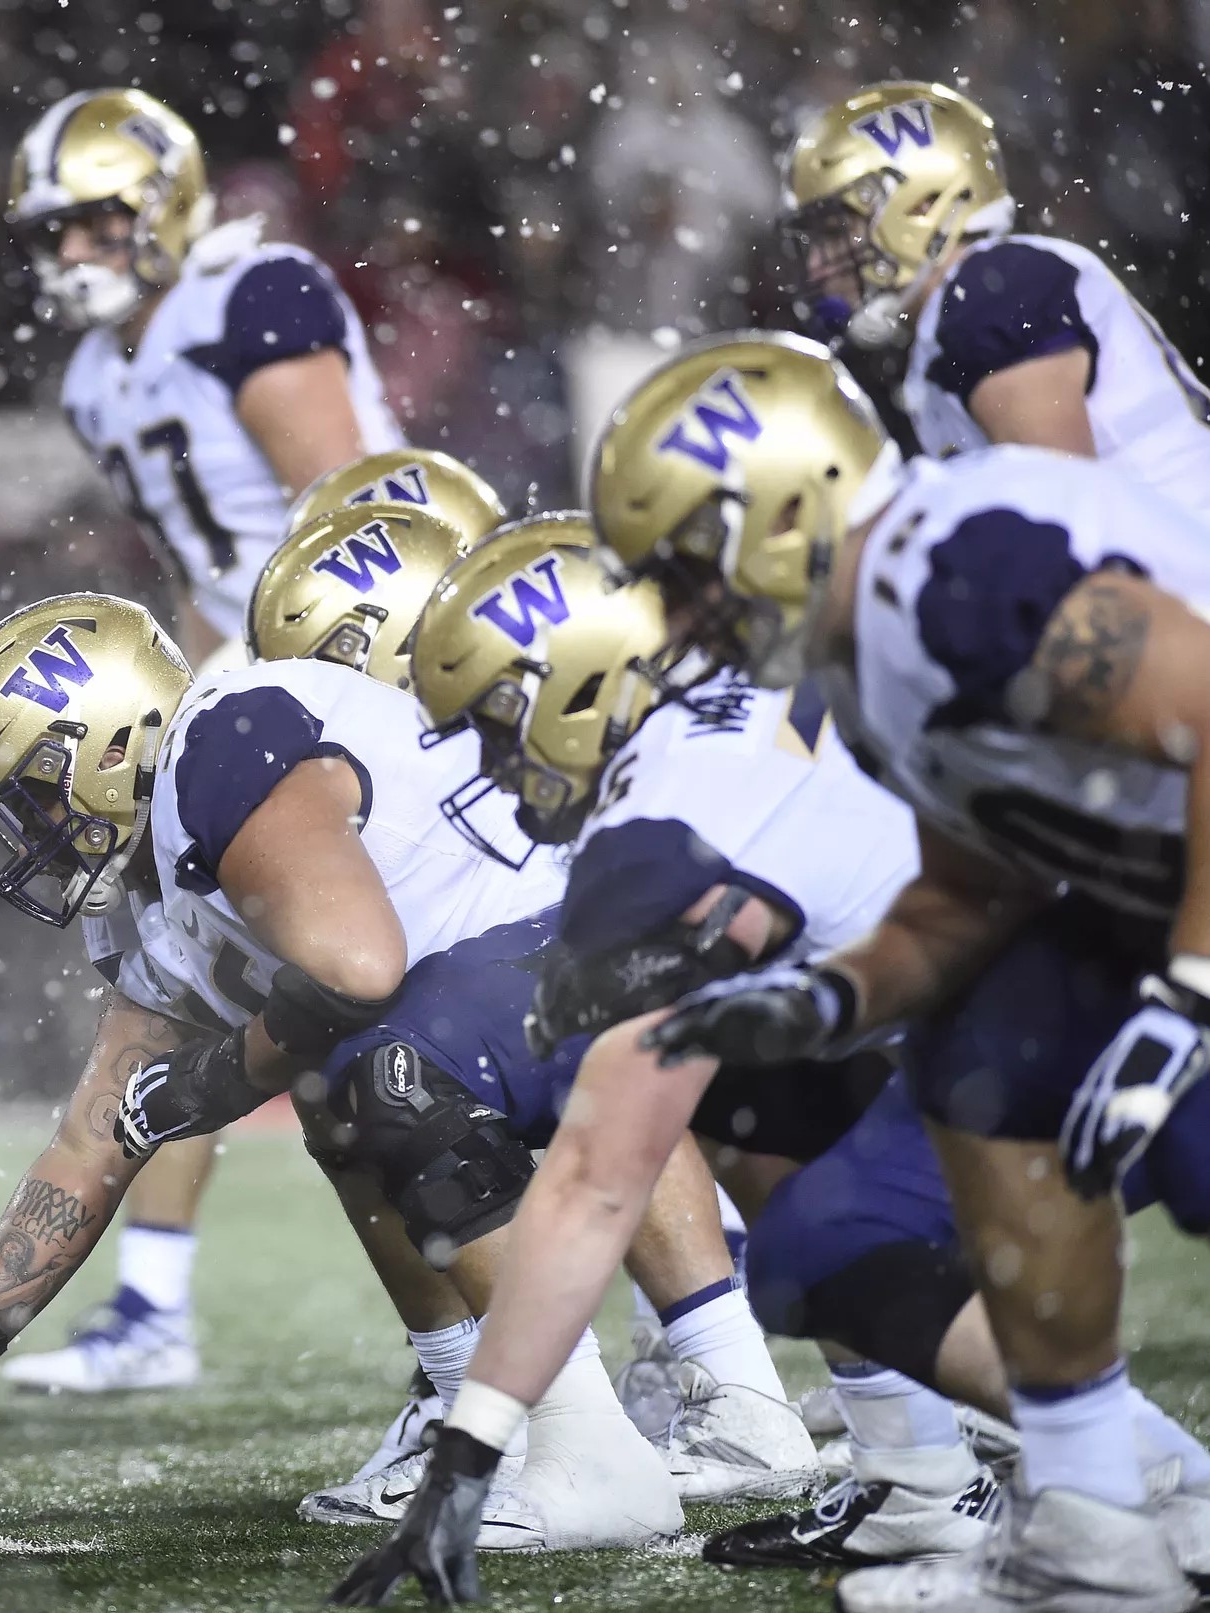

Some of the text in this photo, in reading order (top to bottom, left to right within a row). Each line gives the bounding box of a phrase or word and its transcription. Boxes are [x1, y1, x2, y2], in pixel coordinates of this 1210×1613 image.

[853, 99, 933, 158] W
[656, 373, 763, 472] W
[311, 521, 403, 594] W
[472, 555, 570, 648] W
